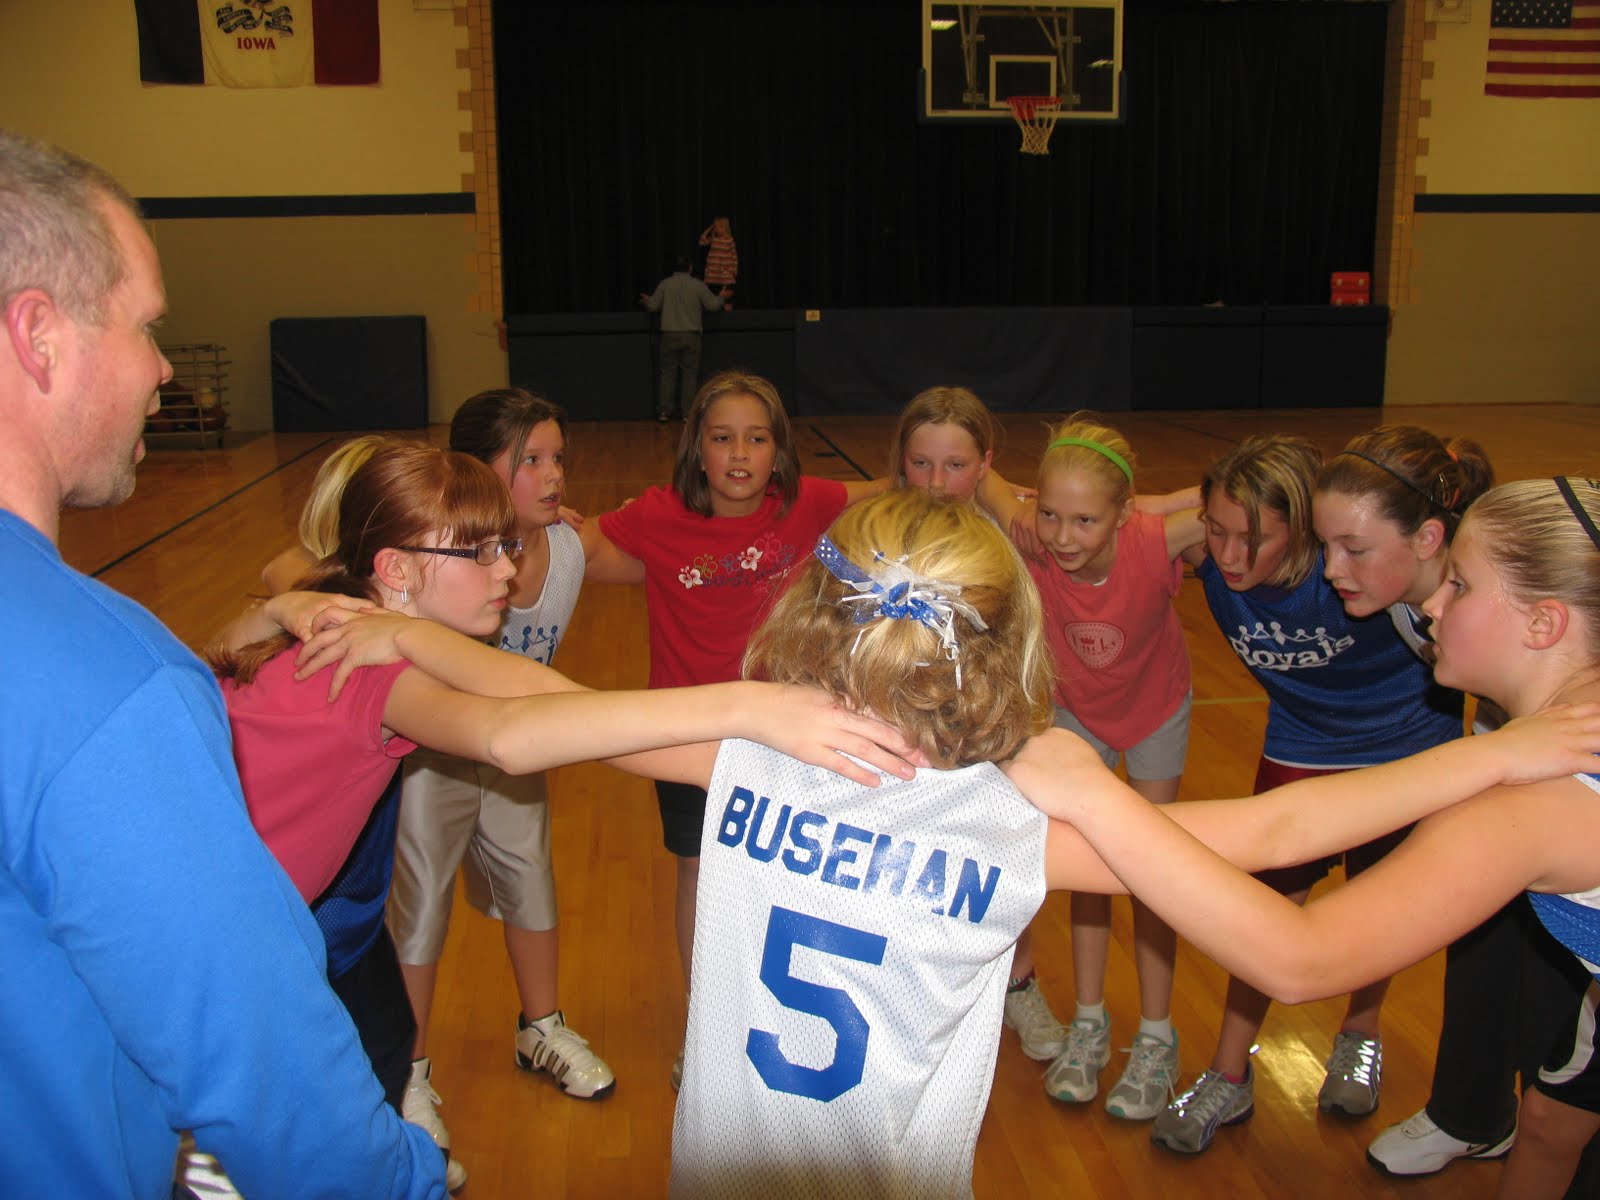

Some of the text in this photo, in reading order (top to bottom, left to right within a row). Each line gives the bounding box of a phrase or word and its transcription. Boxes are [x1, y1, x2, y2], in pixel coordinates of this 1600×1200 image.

[237, 37, 276, 50] IOWA
[1228, 635, 1355, 671] Royals
[717, 786, 1001, 924] BUSEMAN
[746, 905, 888, 1103] 5
